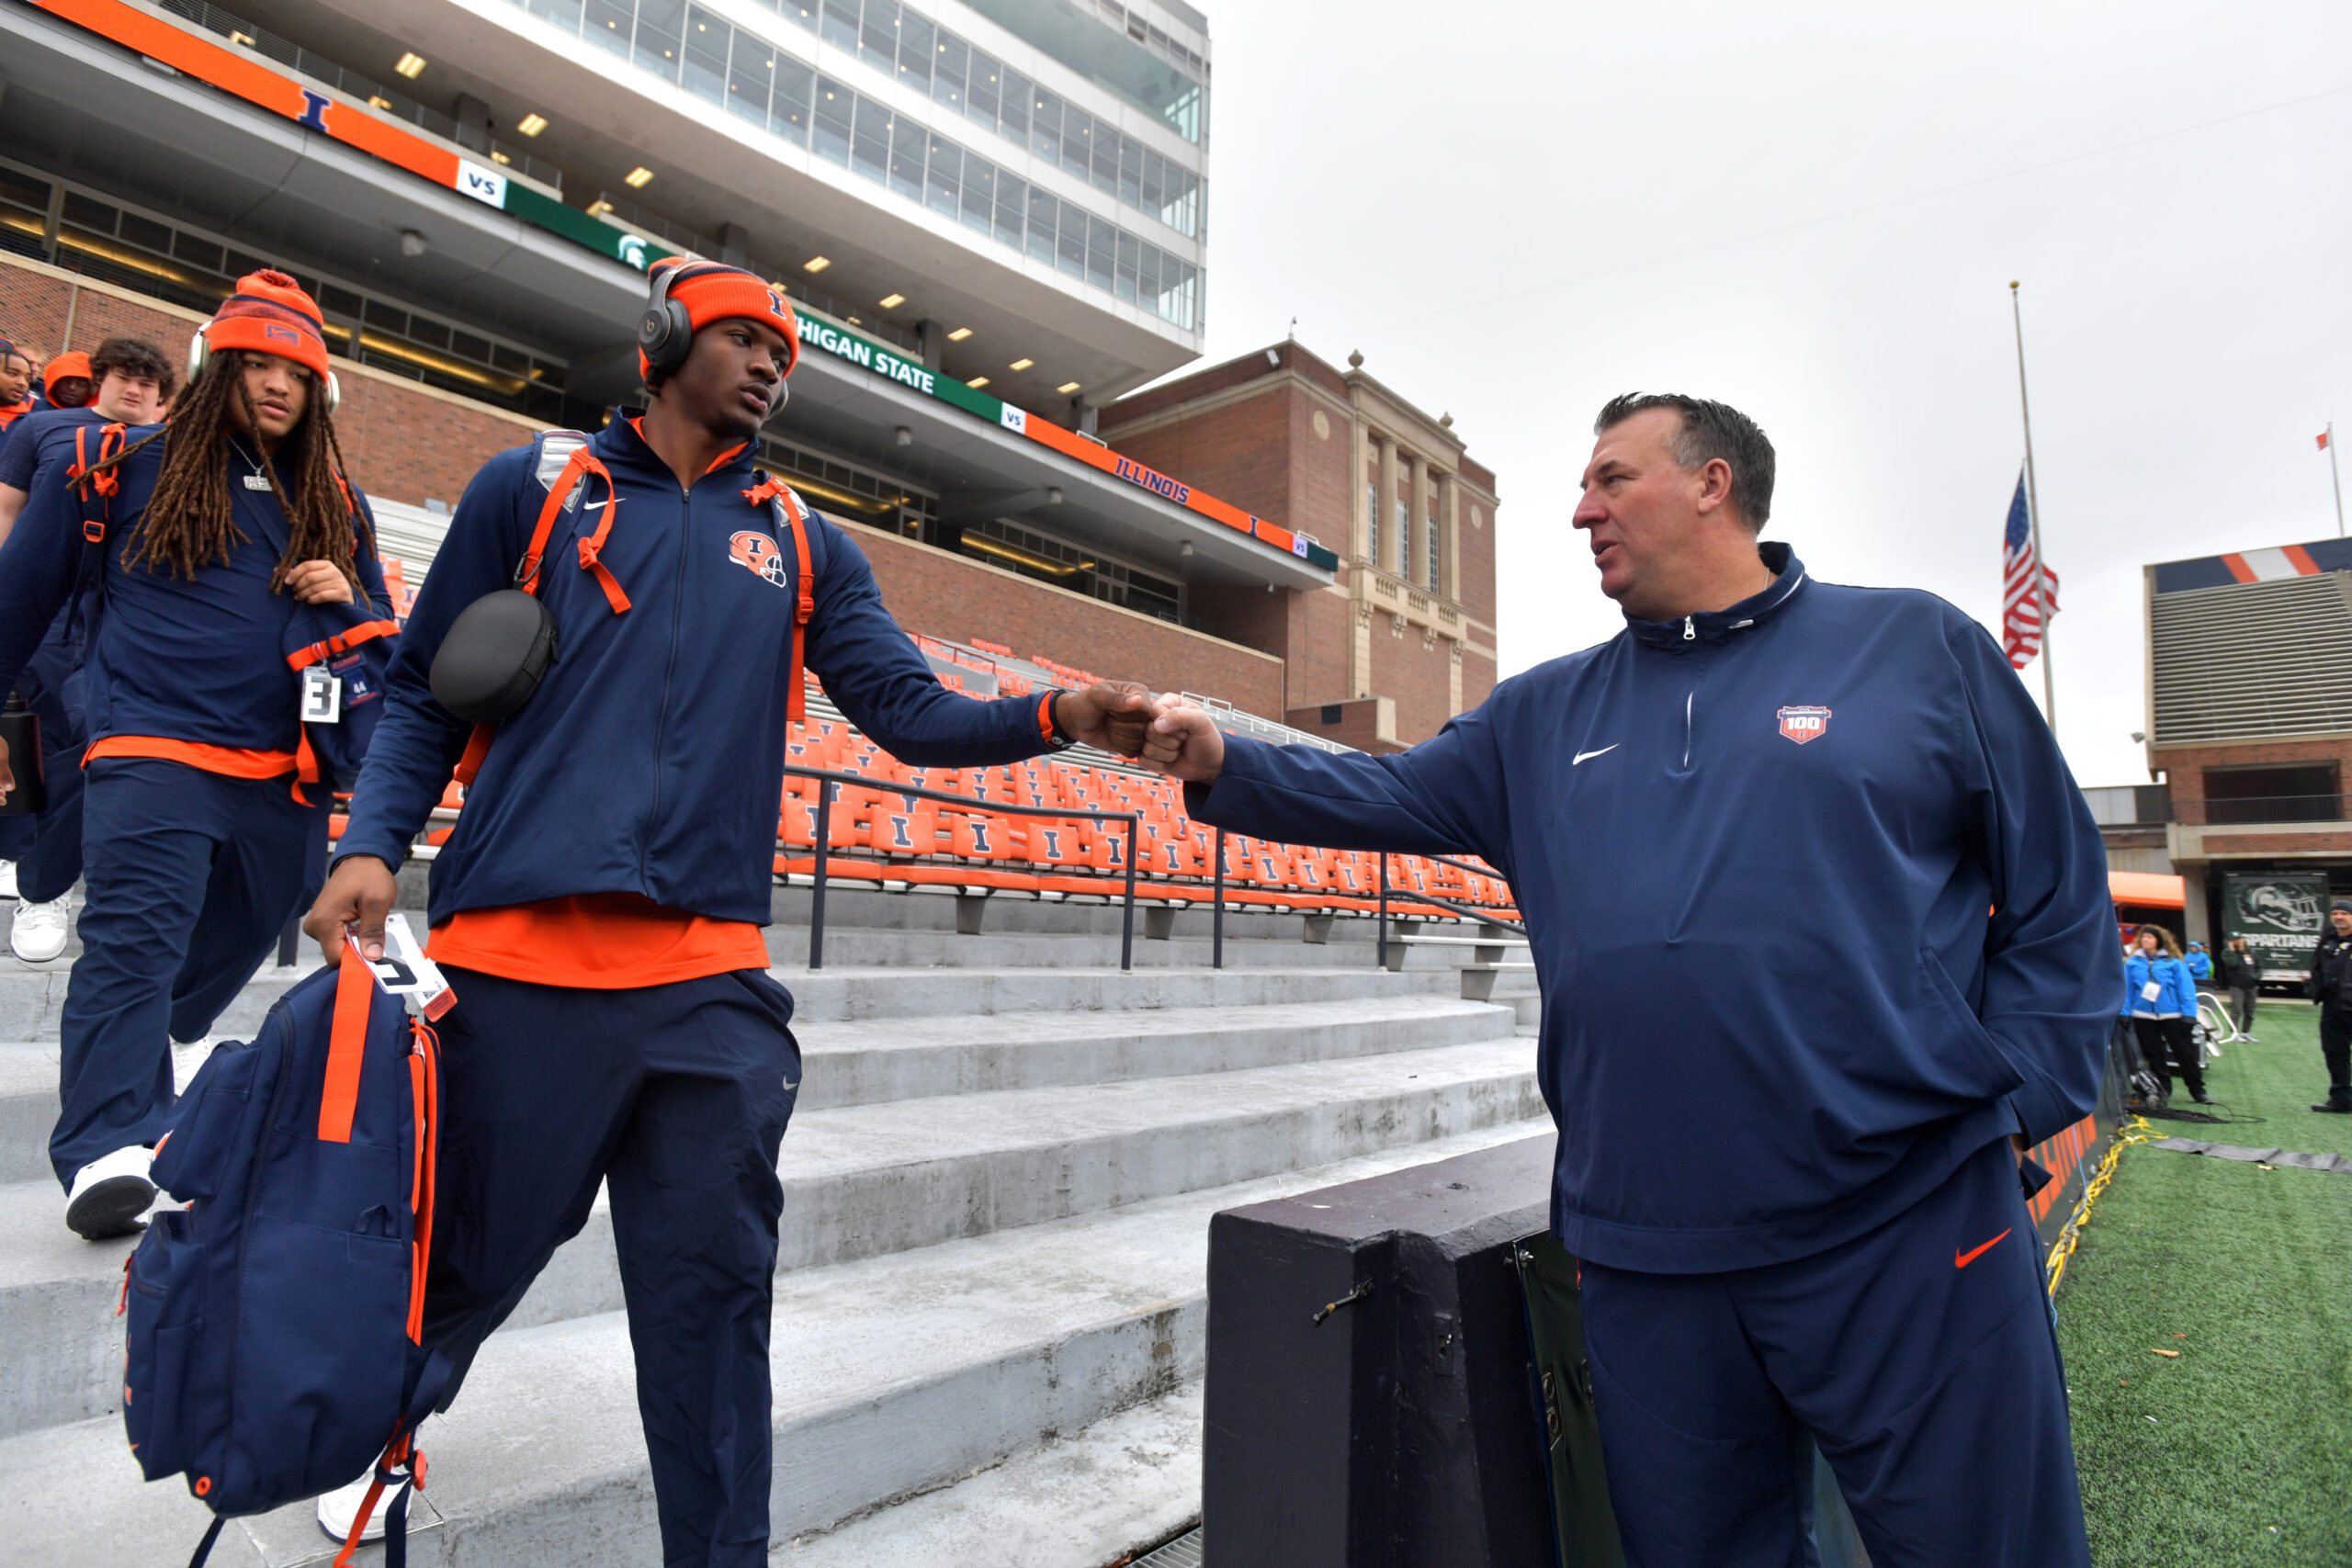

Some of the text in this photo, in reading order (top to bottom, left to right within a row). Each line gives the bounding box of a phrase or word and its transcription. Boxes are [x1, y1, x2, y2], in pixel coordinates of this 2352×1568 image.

[299, 90, 331, 132] I
[768, 290, 786, 318] I
[796, 316, 935, 394] HIGAN STATE
[1114, 457, 1190, 503] ILLINOIS
[1250, 516, 1259, 537] I
[749, 538, 762, 554] I
[308, 675, 333, 716] 3
[1787, 716, 1821, 730] 100
[890, 817, 912, 847] I
[970, 823, 990, 852] I
[1044, 830, 1061, 858] I
[1107, 837, 1123, 863] I
[1238, 837, 1250, 857] I
[1164, 844, 1180, 869] I
[1262, 858, 1278, 879] I
[1304, 864, 1317, 884] I
[1344, 869, 1357, 888] I
[1415, 873, 1424, 891] I
[1470, 880, 1479, 897] I
[1495, 883, 1503, 899] I
[2242, 933, 2321, 948] SPARTANS
